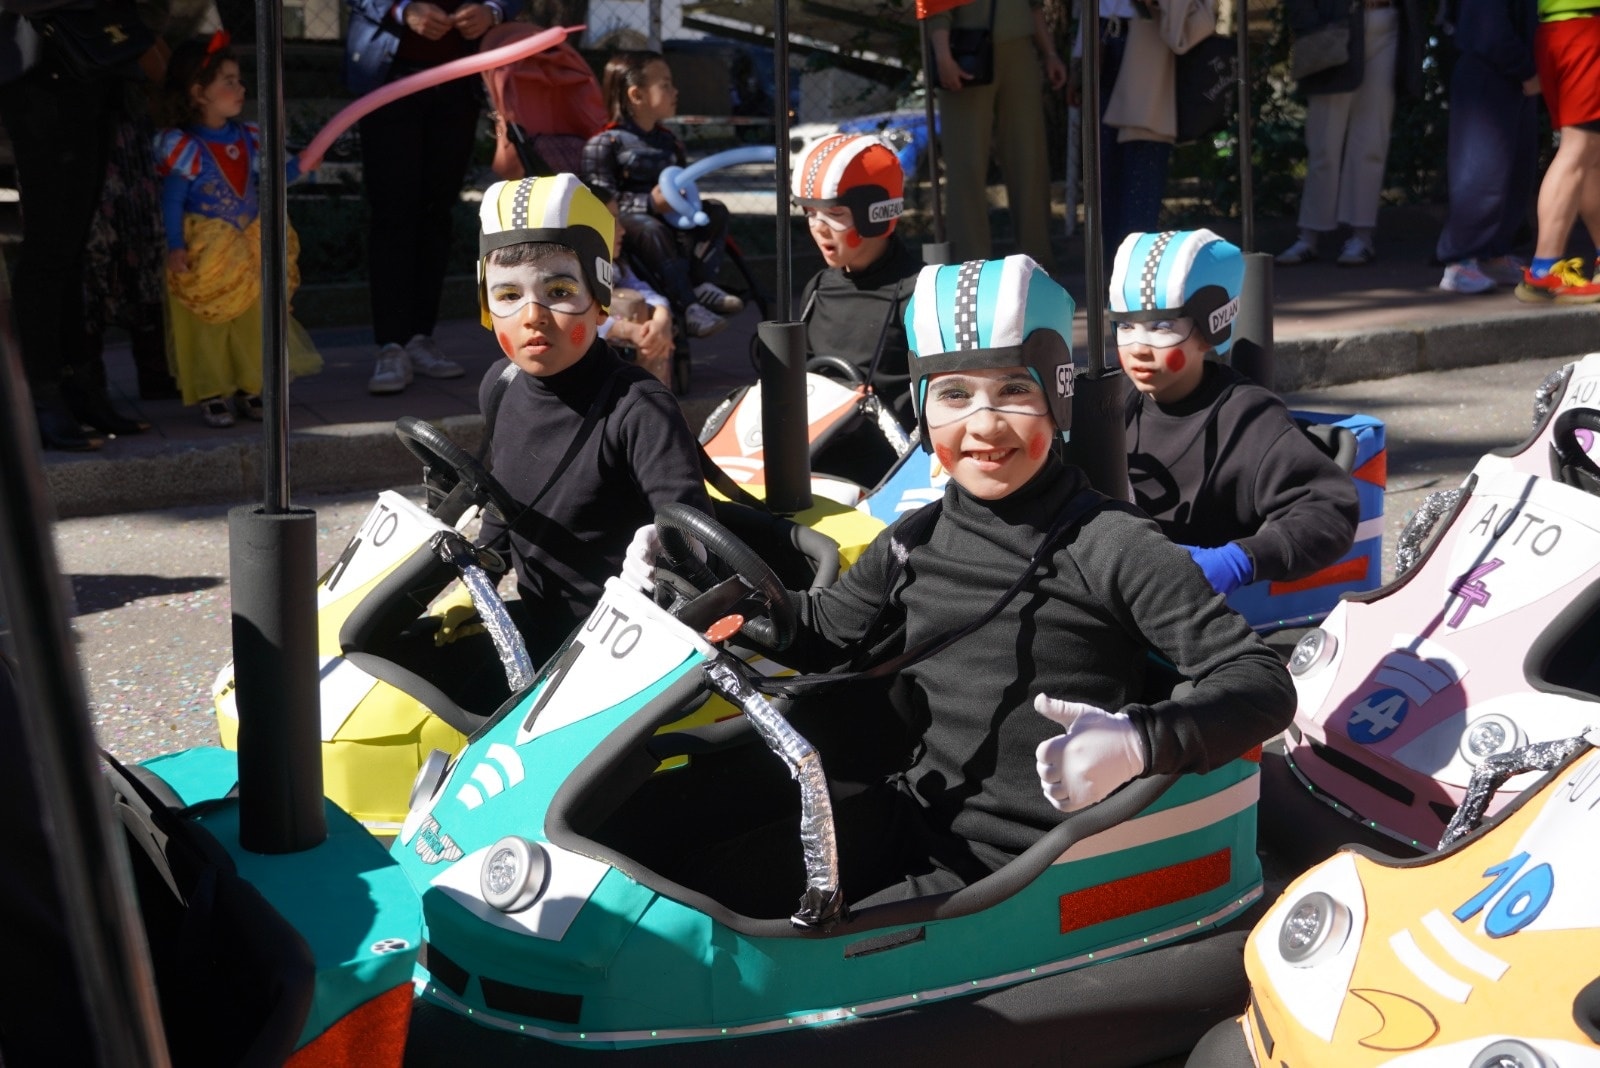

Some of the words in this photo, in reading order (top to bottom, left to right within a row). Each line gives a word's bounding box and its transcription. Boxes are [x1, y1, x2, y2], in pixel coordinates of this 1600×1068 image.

[1212, 299, 1238, 331] DYLAN
[1566, 381, 1600, 407] AU
[1468, 503, 1562, 556] AUTO
[1446, 557, 1505, 629] 4
[1452, 851, 1554, 939] 10
